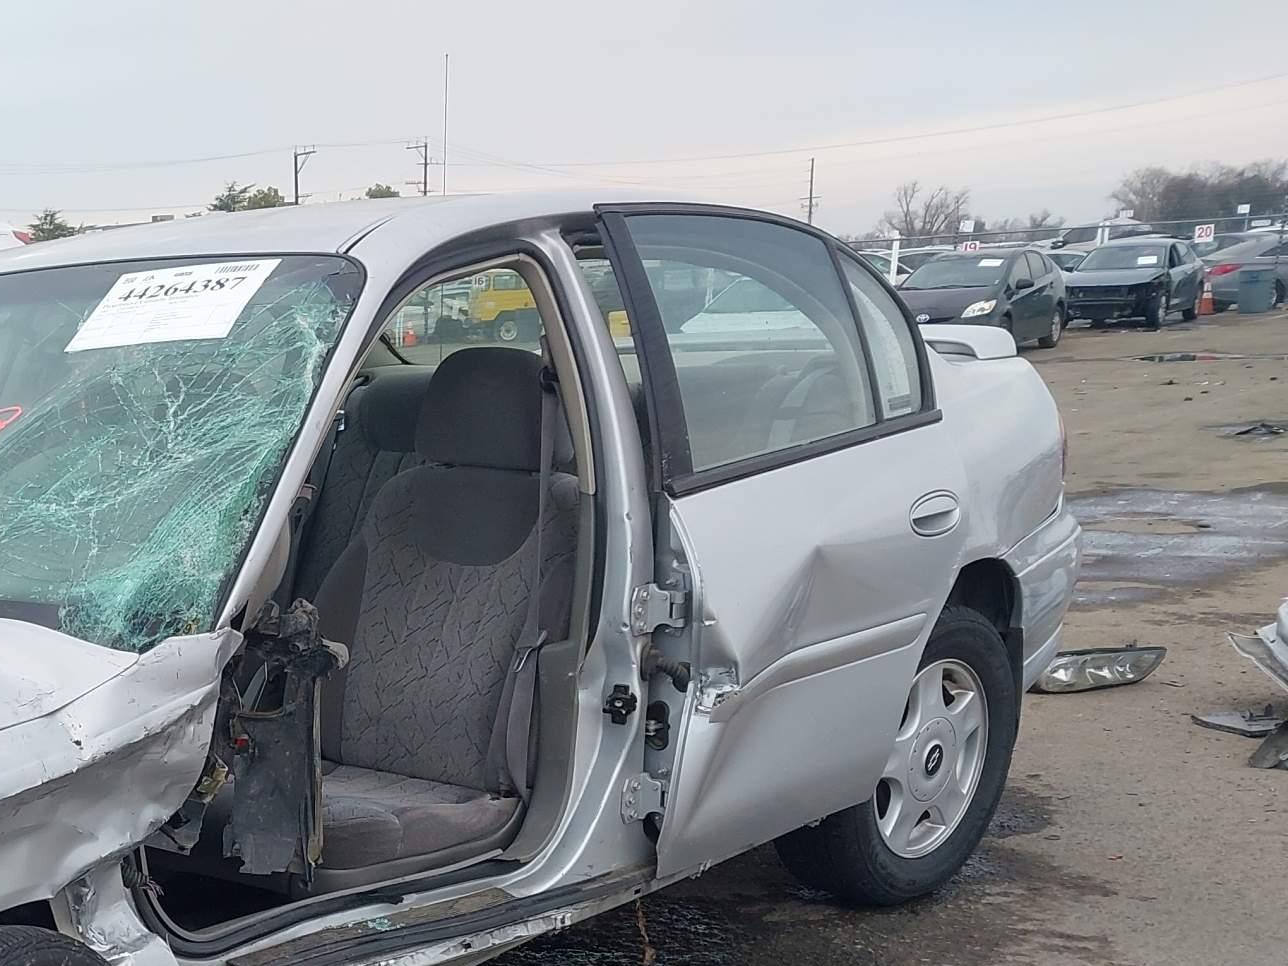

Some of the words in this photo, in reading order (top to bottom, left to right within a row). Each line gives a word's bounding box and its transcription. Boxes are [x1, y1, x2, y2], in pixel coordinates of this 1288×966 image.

[1196, 225, 1213, 239] 20
[473, 276, 485, 286] 16
[118, 275, 249, 302] 44264387
